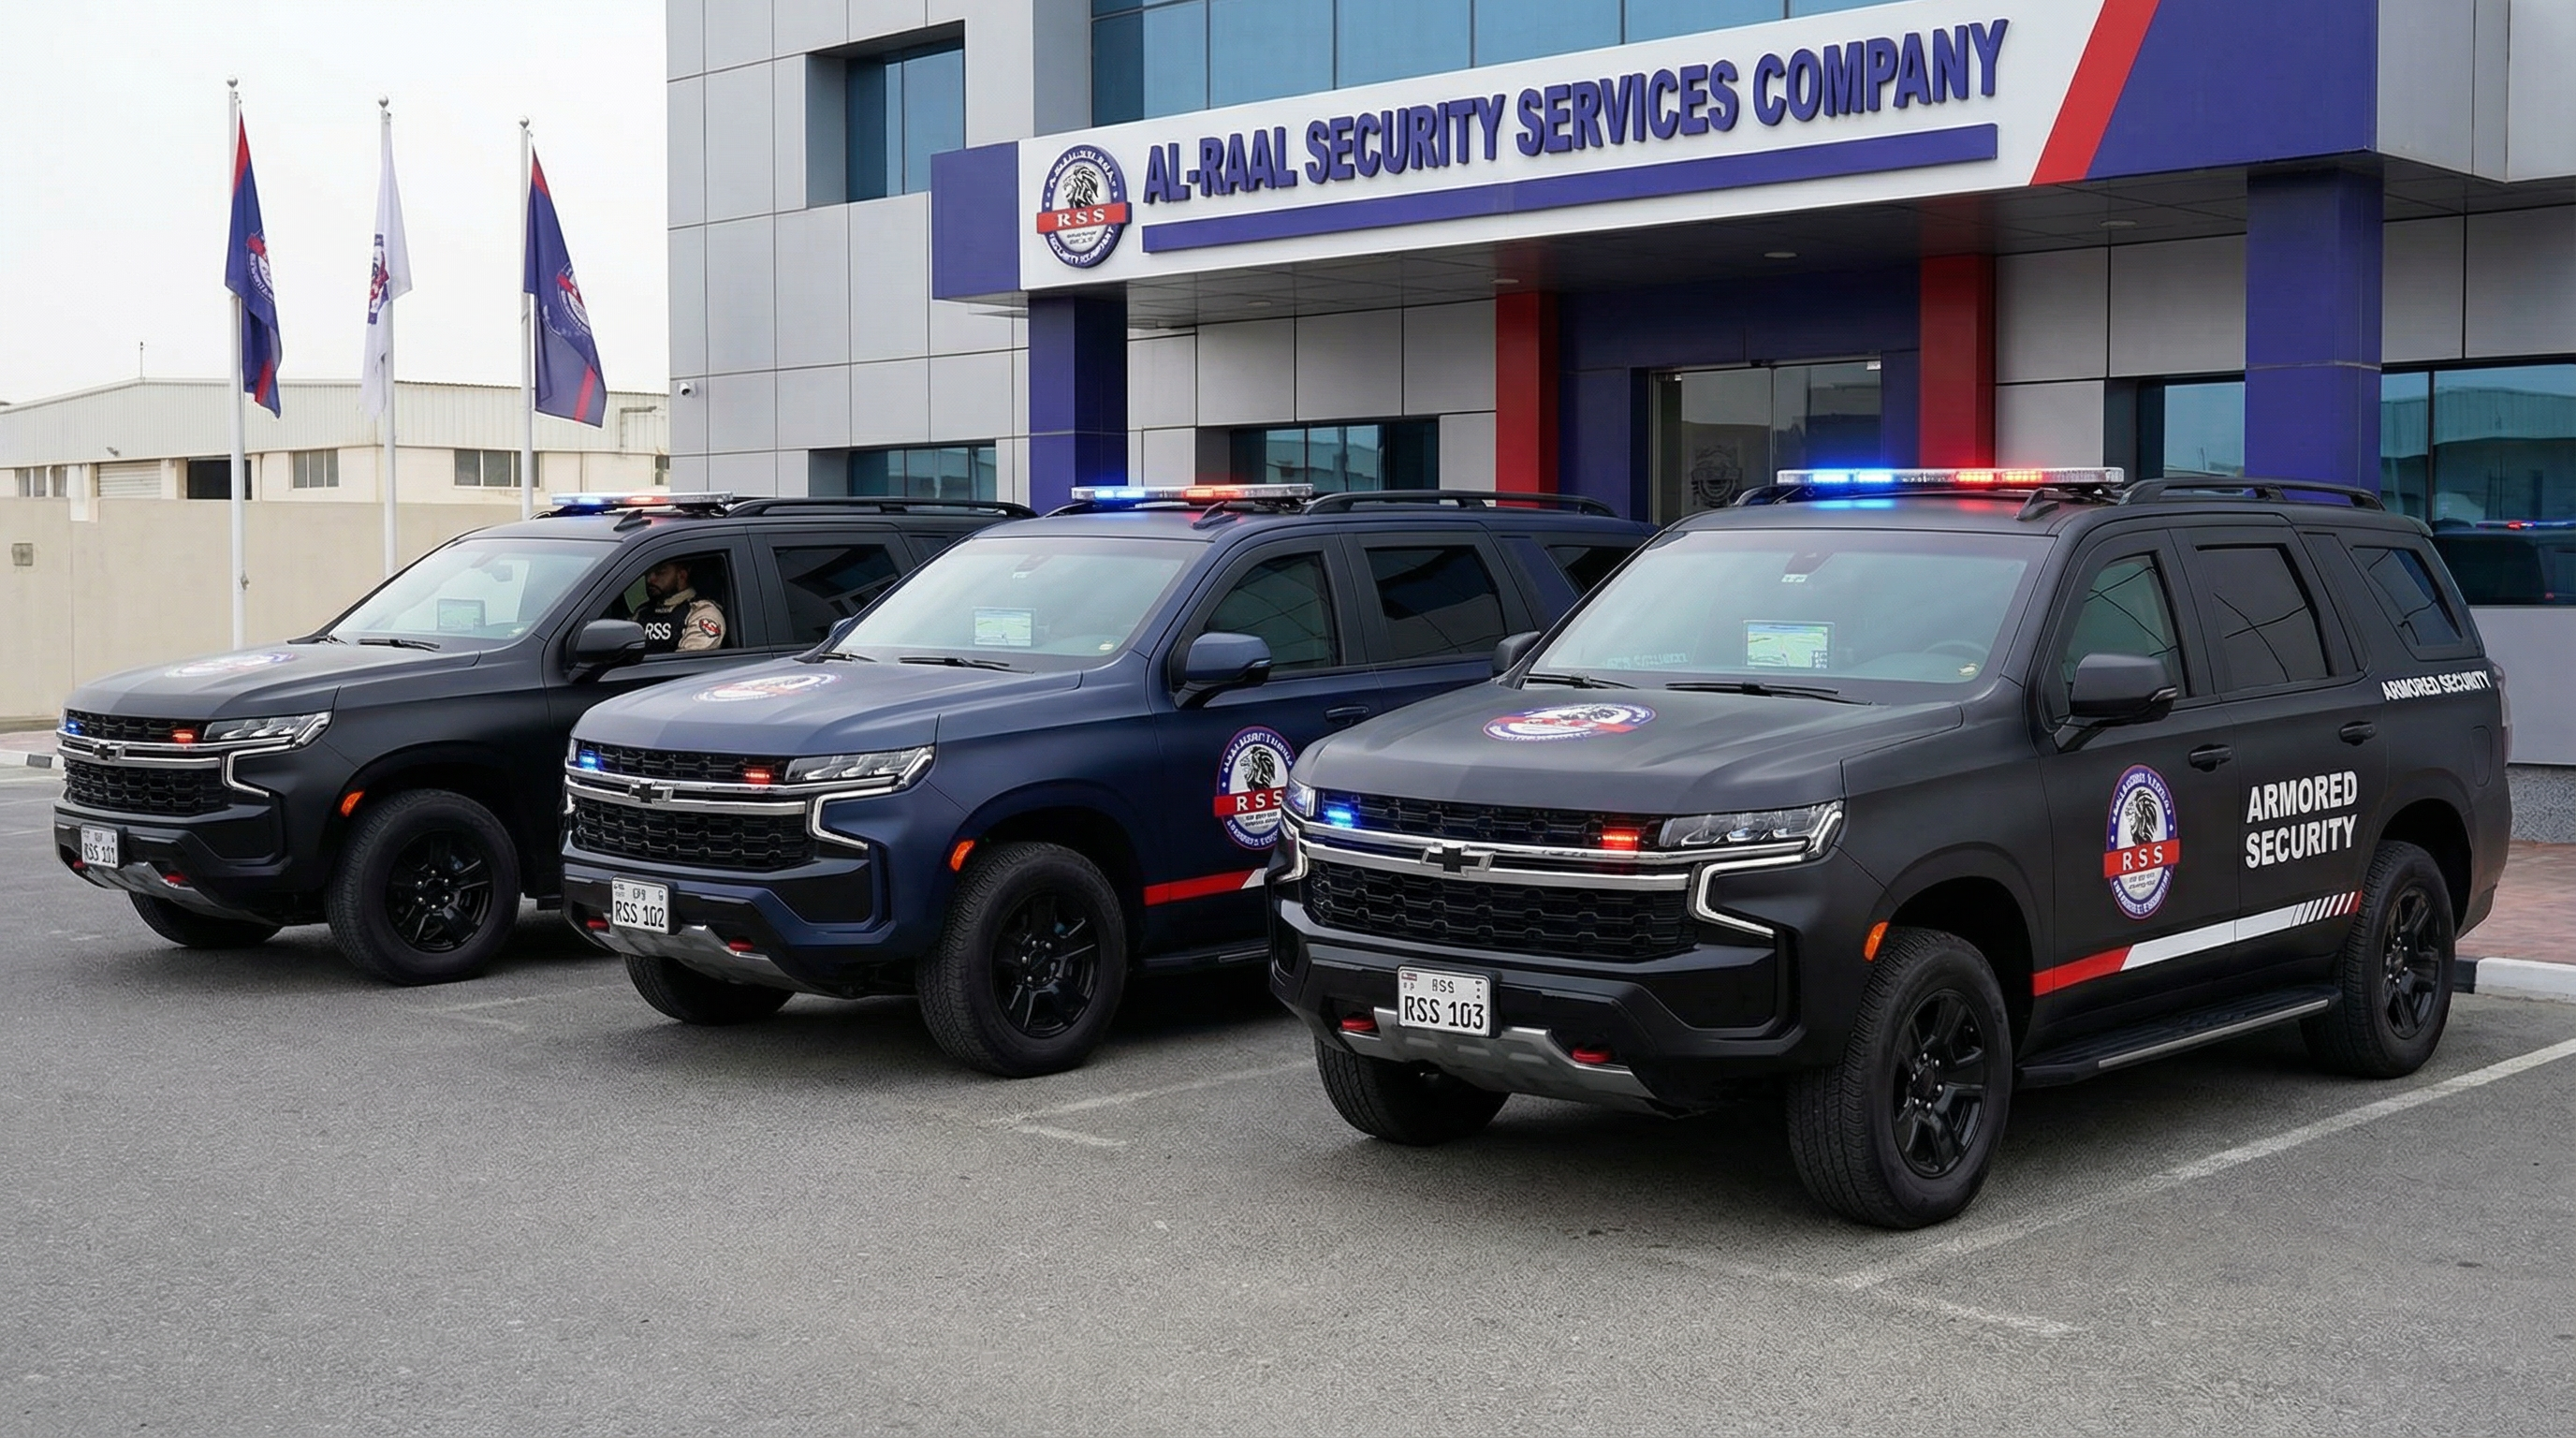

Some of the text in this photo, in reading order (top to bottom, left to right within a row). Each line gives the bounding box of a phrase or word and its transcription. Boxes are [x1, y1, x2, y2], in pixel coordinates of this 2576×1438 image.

[1143, 126, 1297, 204] AL-RAAL
[1306, 94, 1506, 184] SECURITY
[1515, 59, 1739, 157] SERVICES
[1752, 18, 2009, 126] COMPANY
[1057, 208, 1105, 227] RSS
[645, 623, 671, 639] RSS
[2380, 670, 2491, 700] ARMORED SECURITY
[1236, 790, 1283, 812] RSS
[2246, 770, 2359, 824] ARMORED
[2246, 814, 2358, 869] SECURITY
[2122, 845, 2163, 872] RSS
[615, 901, 665, 928] RSS 102
[1404, 995, 1485, 1030] RSS 103
